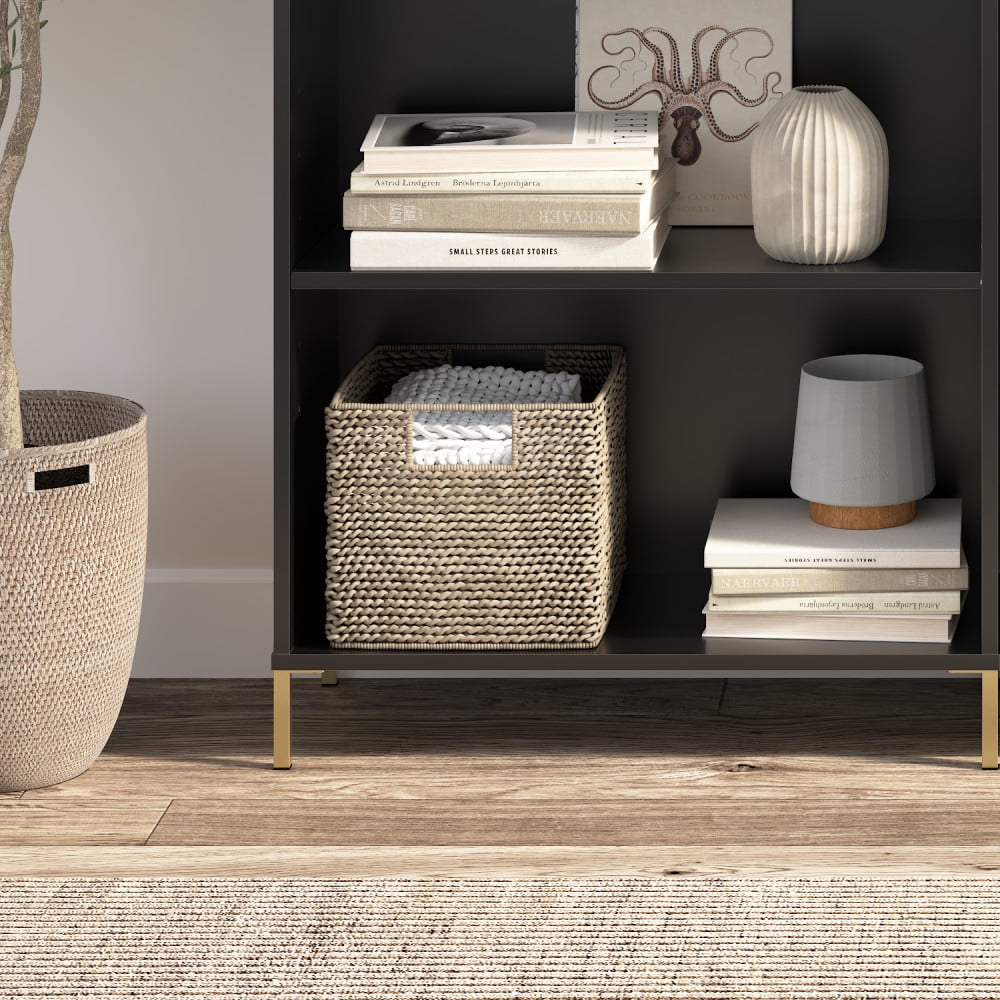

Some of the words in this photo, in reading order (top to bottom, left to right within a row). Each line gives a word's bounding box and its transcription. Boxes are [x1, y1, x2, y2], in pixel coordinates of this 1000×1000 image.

[374, 179, 400, 188] Astrid
[402, 178, 441, 190] Lindgren
[537, 209, 633, 225] NAERVAER
[449, 248, 473, 256] SMALL
[475, 248, 499, 256] STEPS
[501, 248, 525, 256] GREAT
[527, 248, 558, 256] STORIES
[720, 576, 800, 589] NAERVAER
[883, 600, 917, 610] Lindgren
[918, 602, 942, 610] Astrid
